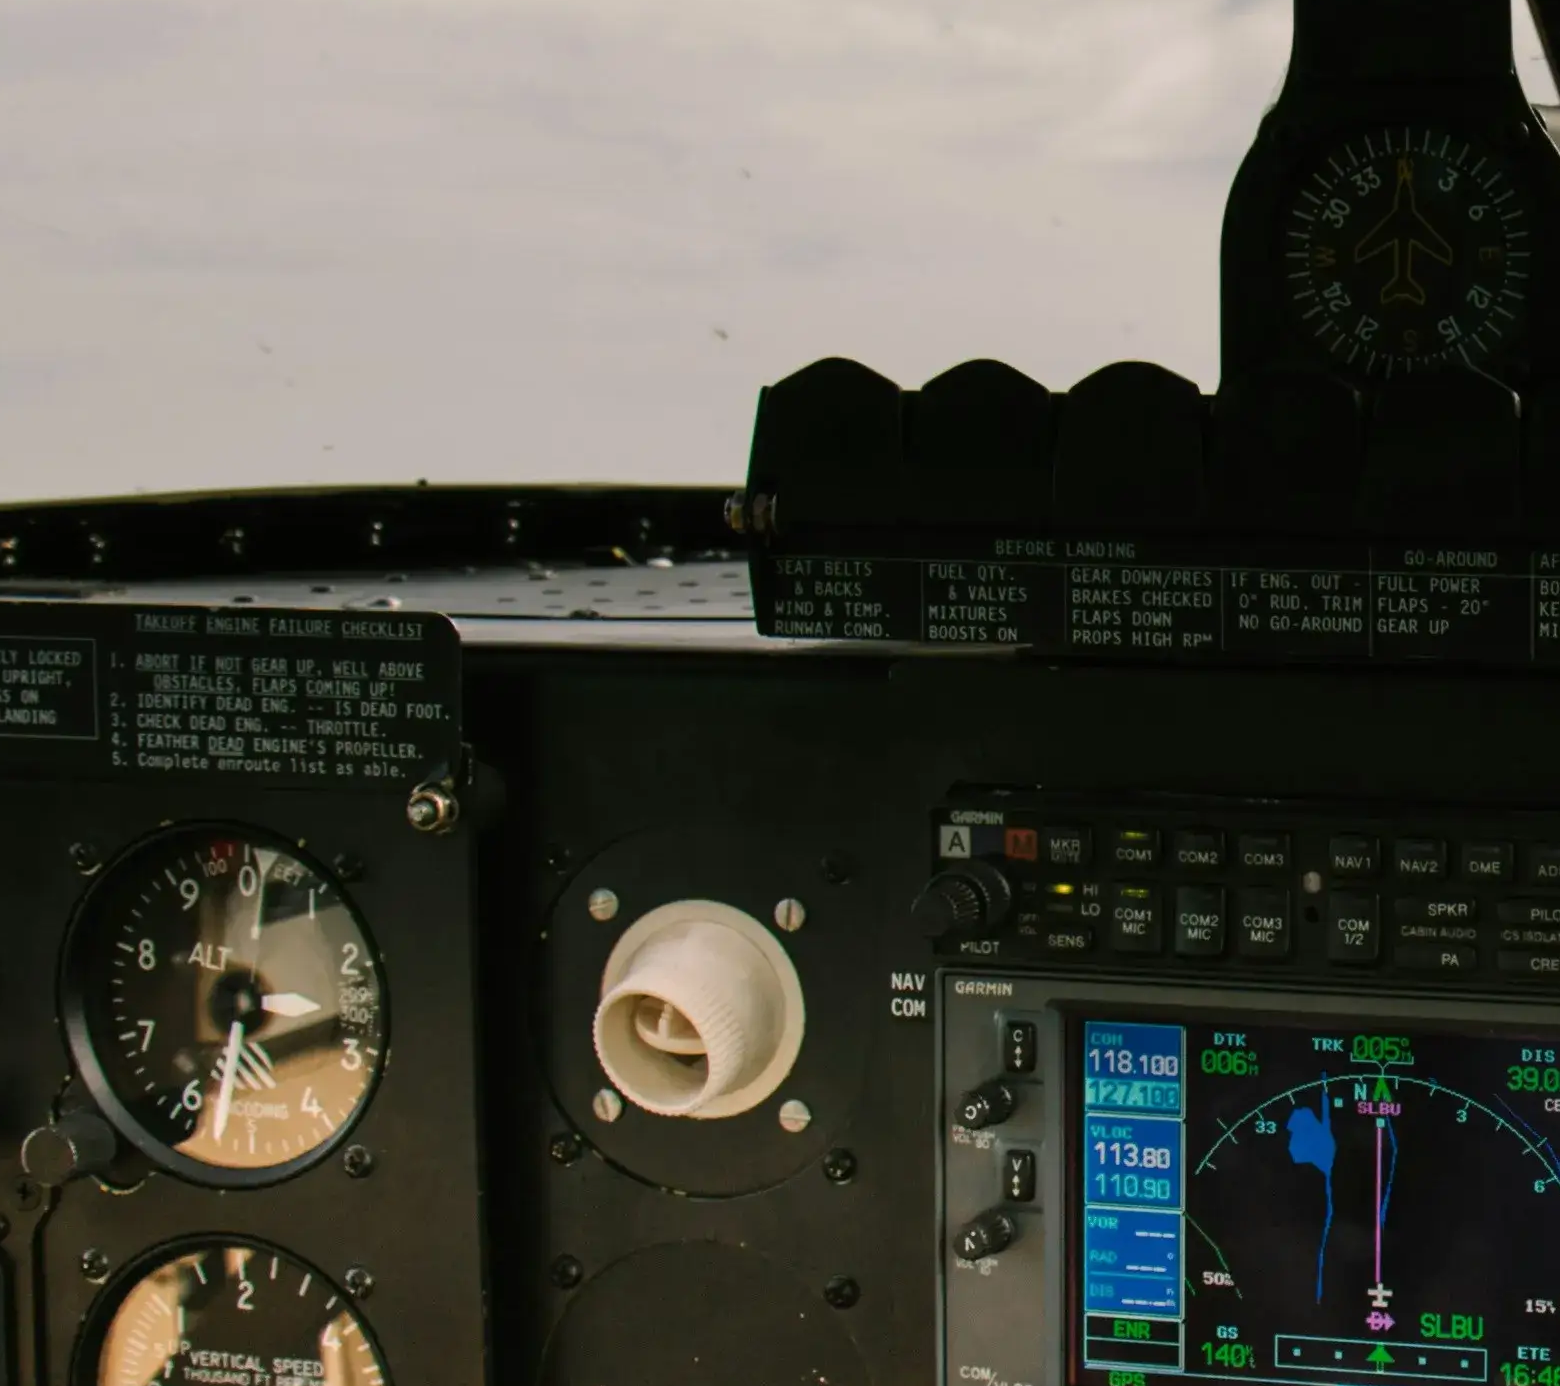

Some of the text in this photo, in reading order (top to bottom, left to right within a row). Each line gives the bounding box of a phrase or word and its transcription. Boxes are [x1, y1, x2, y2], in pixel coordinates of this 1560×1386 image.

[1350, 167, 1381, 195] 33
[1323, 199, 1352, 228] 30
[995, 540, 1135, 559] BEFORE LANDING
[775, 559, 872, 577] SEAT BELTS
[1404, 550, 1498, 569] GO-AROUND
[1071, 568, 1212, 587] GEAR DOWN/PRES
[1072, 589, 1212, 608] BRAKES CHECKED
[135, 614, 424, 637] TAKEOFF ENGINE FAILURE CHECKLIST
[29, 651, 80, 667] LOCKED
[21, 689, 39, 704] ON
[1115, 848, 1152, 863] COM1
[1179, 850, 1218, 865] COM2
[1245, 852, 1284, 866] COM3
[1335, 854, 1371, 869] NAV1
[180, 878, 199, 909] 9
[138, 940, 156, 972] 8
[188, 942, 231, 973] ALT
[341, 943, 359, 973] 2
[890, 973, 925, 991] NAV
[891, 998, 925, 1017] COM
[1214, 1033, 1246, 1046] DTK
[1312, 1037, 1344, 1053] TRK
[1088, 1049, 1179, 1076] 118.100
[1522, 1049, 1555, 1063] DIS
[1091, 1125, 1131, 1139] VLOC
[1094, 1143, 1170, 1170] 113.80
[1094, 1174, 1170, 1199] 110.90
[1420, 1313, 1484, 1340] SLBU
[1517, 1346, 1550, 1361] ETE
[190, 1350, 323, 1378] VERTICAL SPEED
